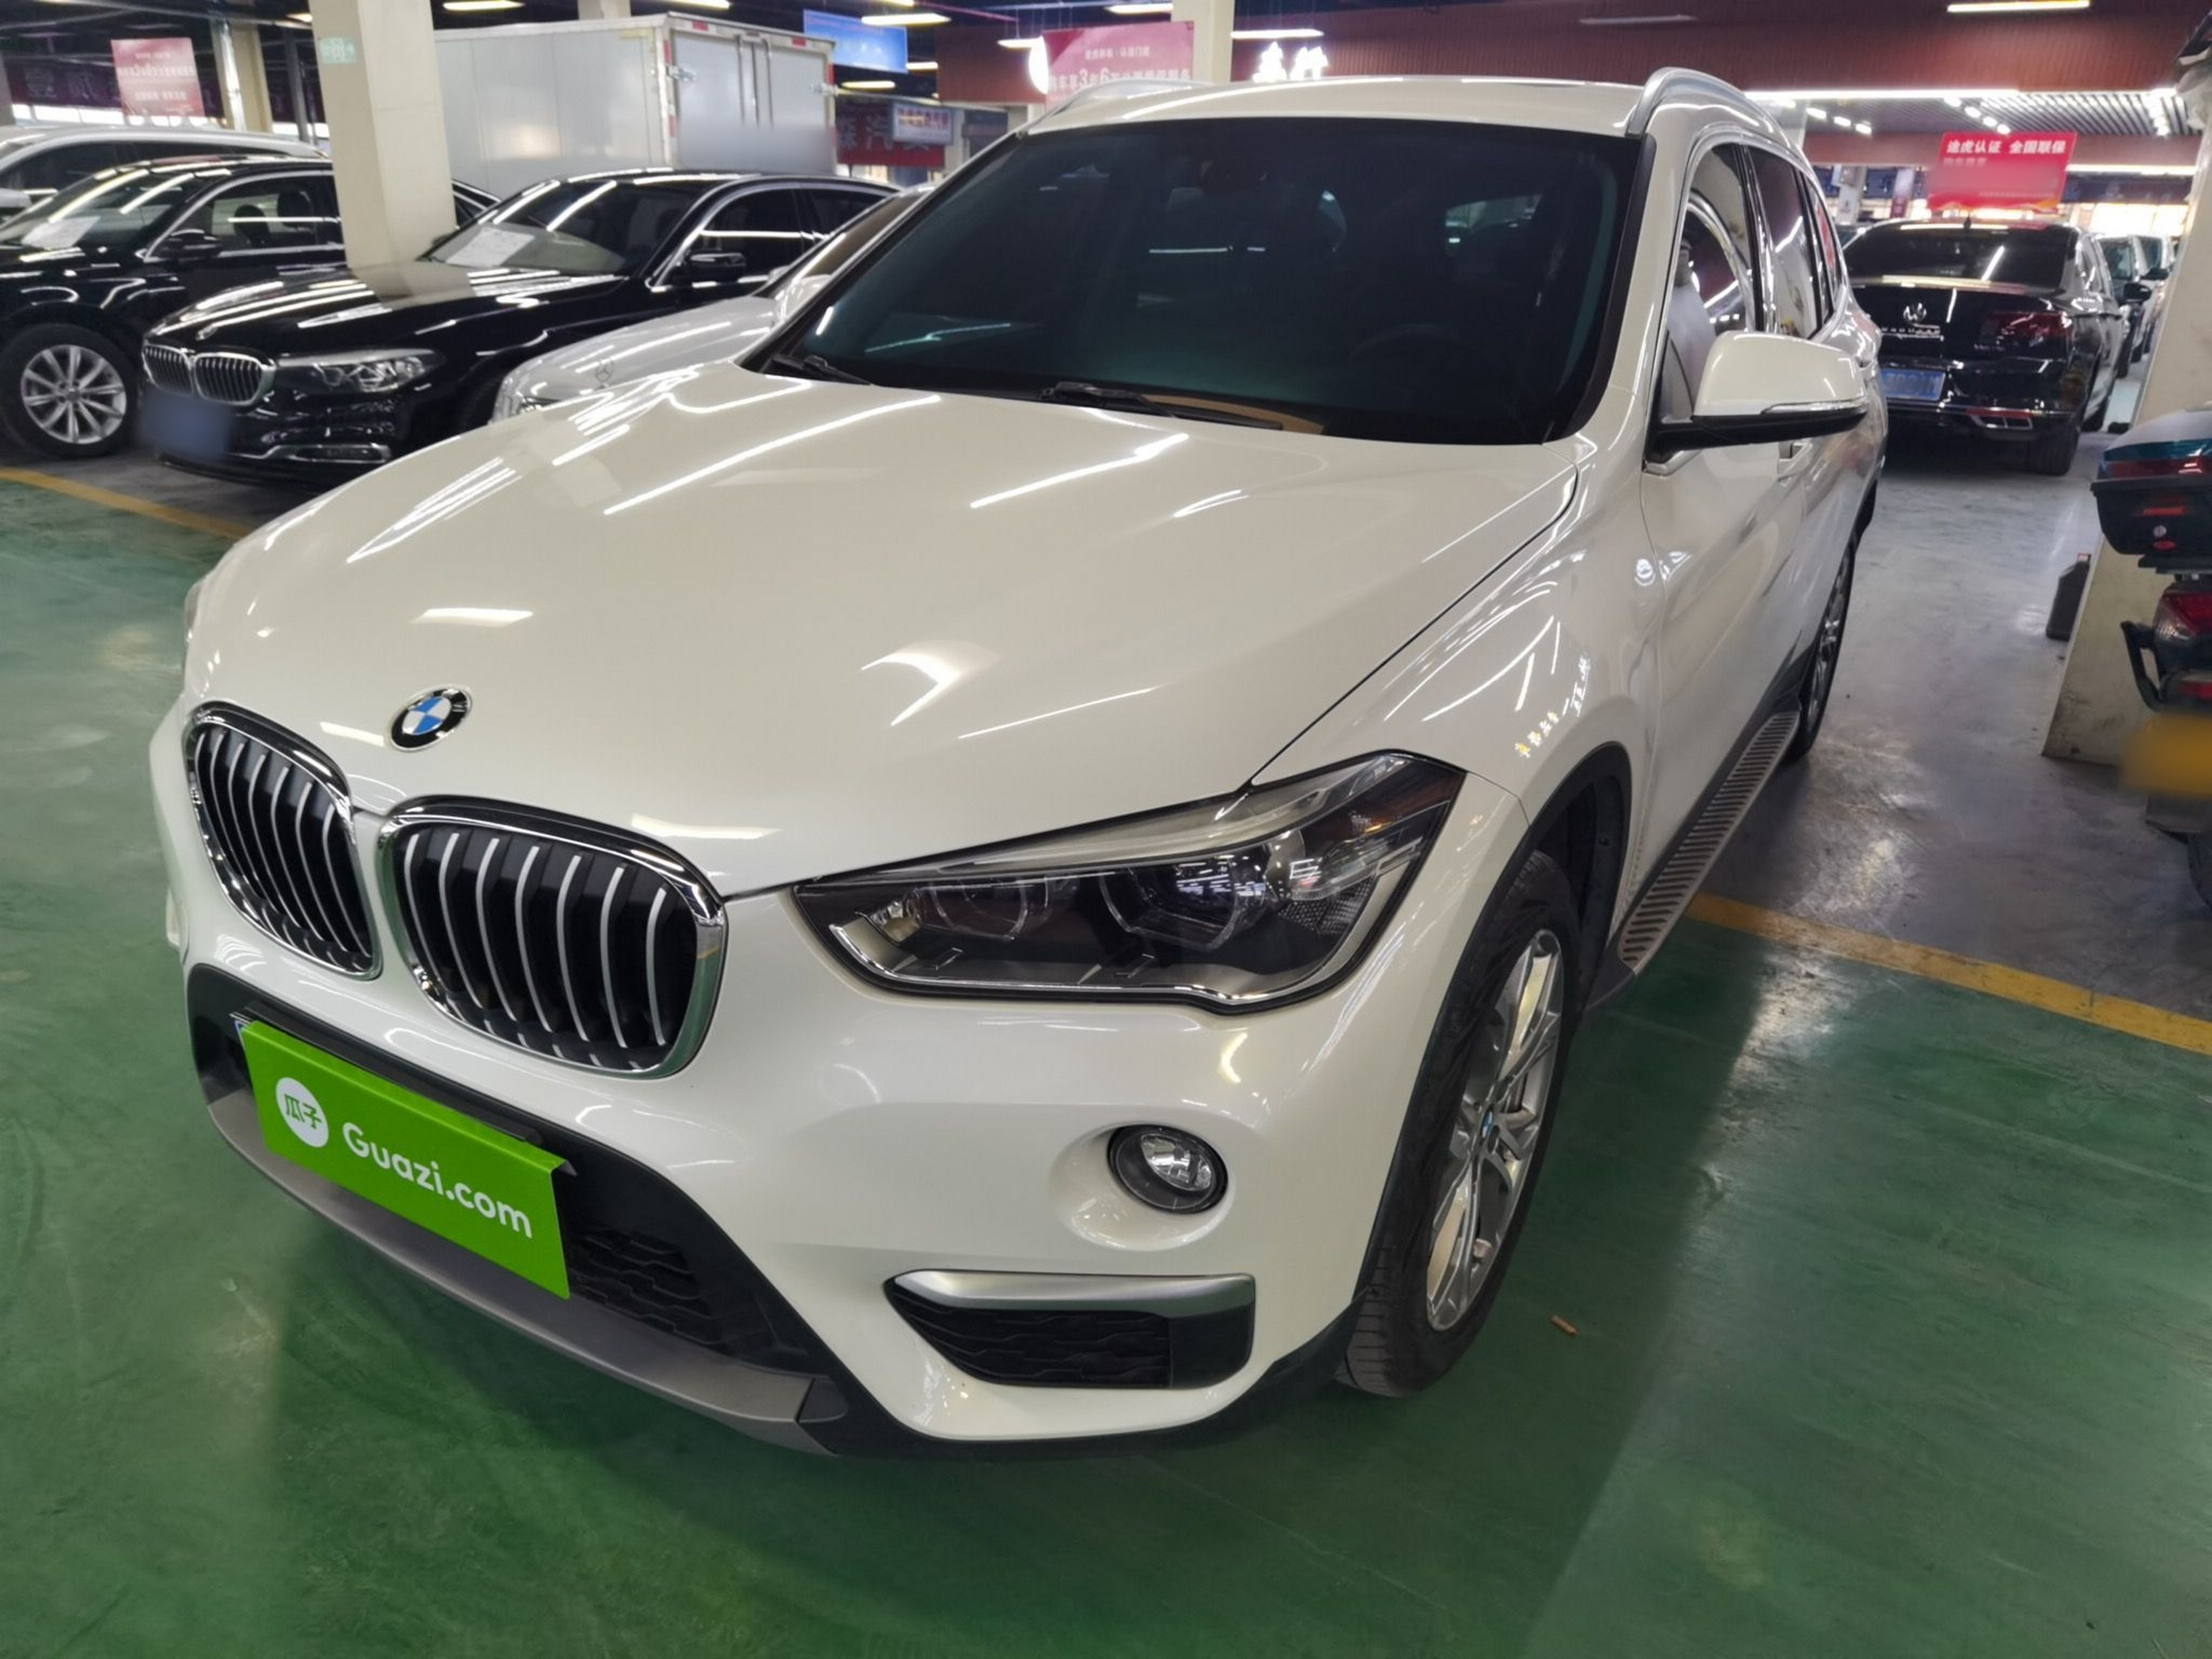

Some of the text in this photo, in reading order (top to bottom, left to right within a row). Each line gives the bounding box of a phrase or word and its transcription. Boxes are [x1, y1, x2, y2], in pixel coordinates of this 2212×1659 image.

[2009, 139, 2066, 154] 全国联保
[284, 1093, 322, 1130] 瓜子
[343, 1122, 533, 1238] Guazi.com
